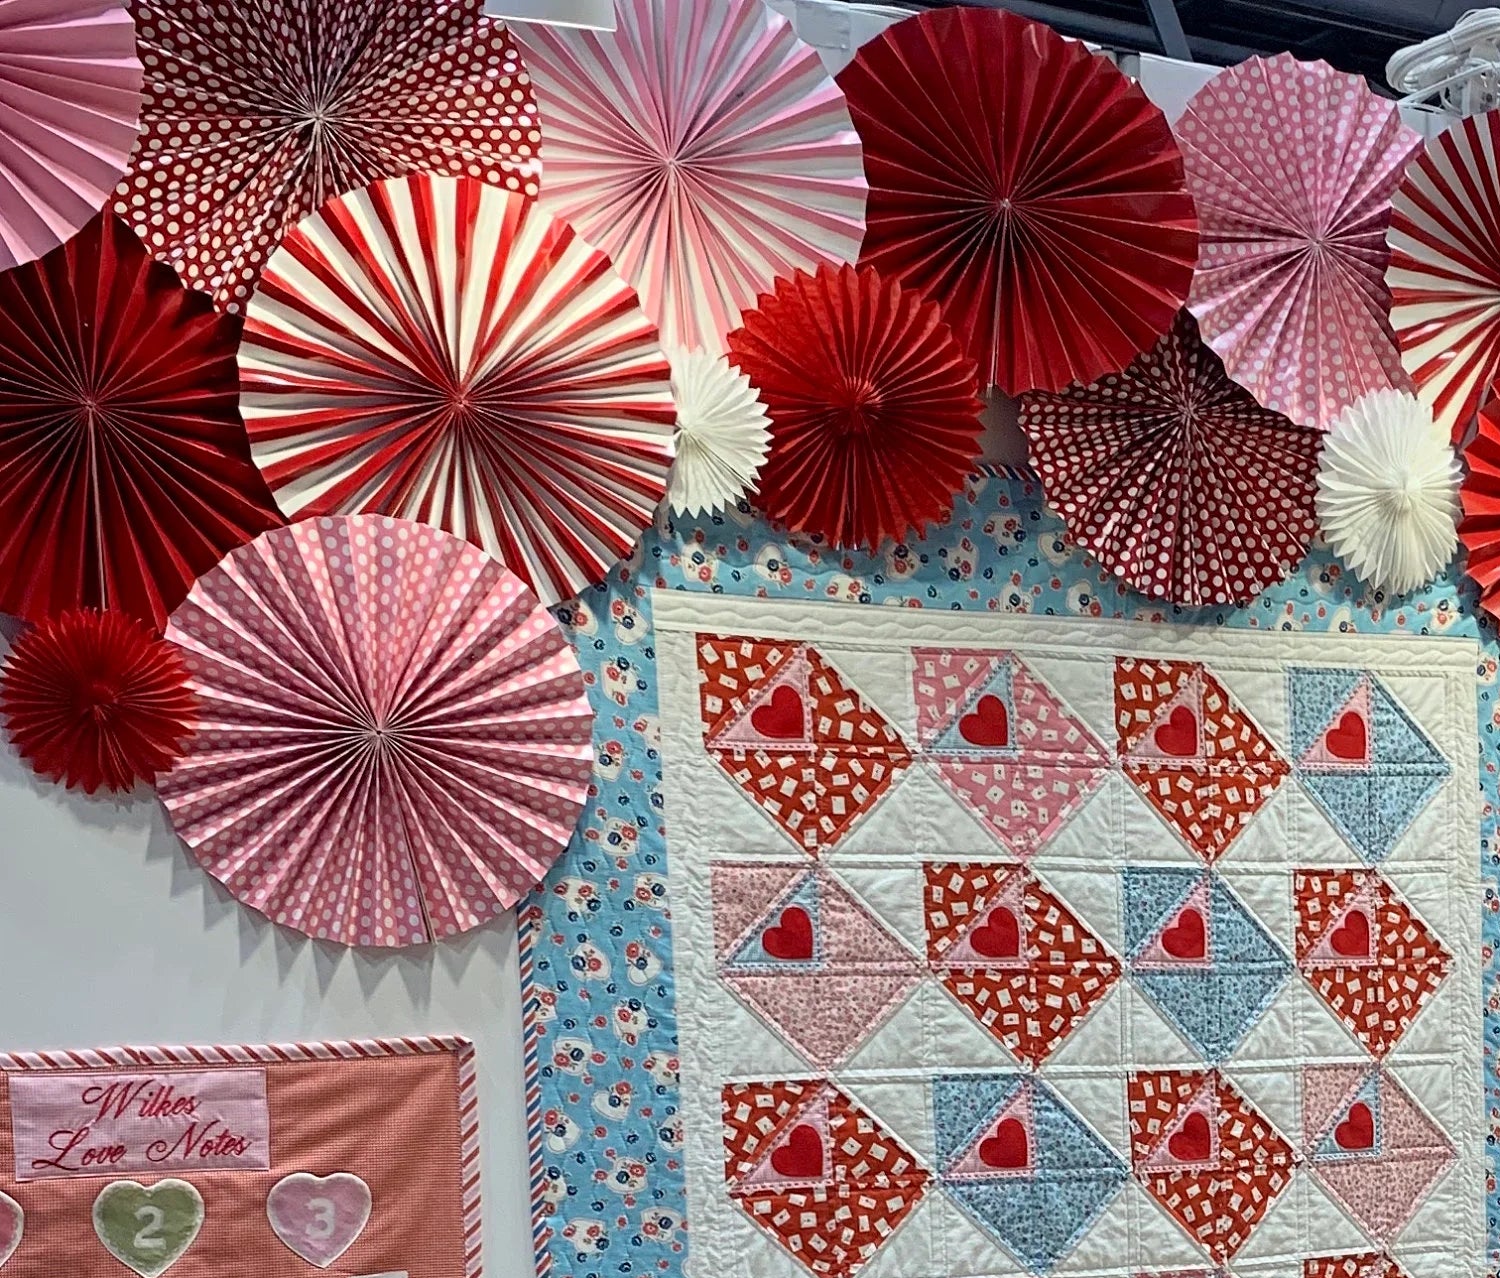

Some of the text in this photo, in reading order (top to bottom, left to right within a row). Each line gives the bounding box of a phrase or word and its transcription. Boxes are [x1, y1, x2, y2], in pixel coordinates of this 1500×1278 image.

[82, 1079, 201, 1123] Wilkes
[31, 1120, 252, 1171] Love Notes
[133, 1206, 166, 1248] 2
[305, 1199, 335, 1239] 3
